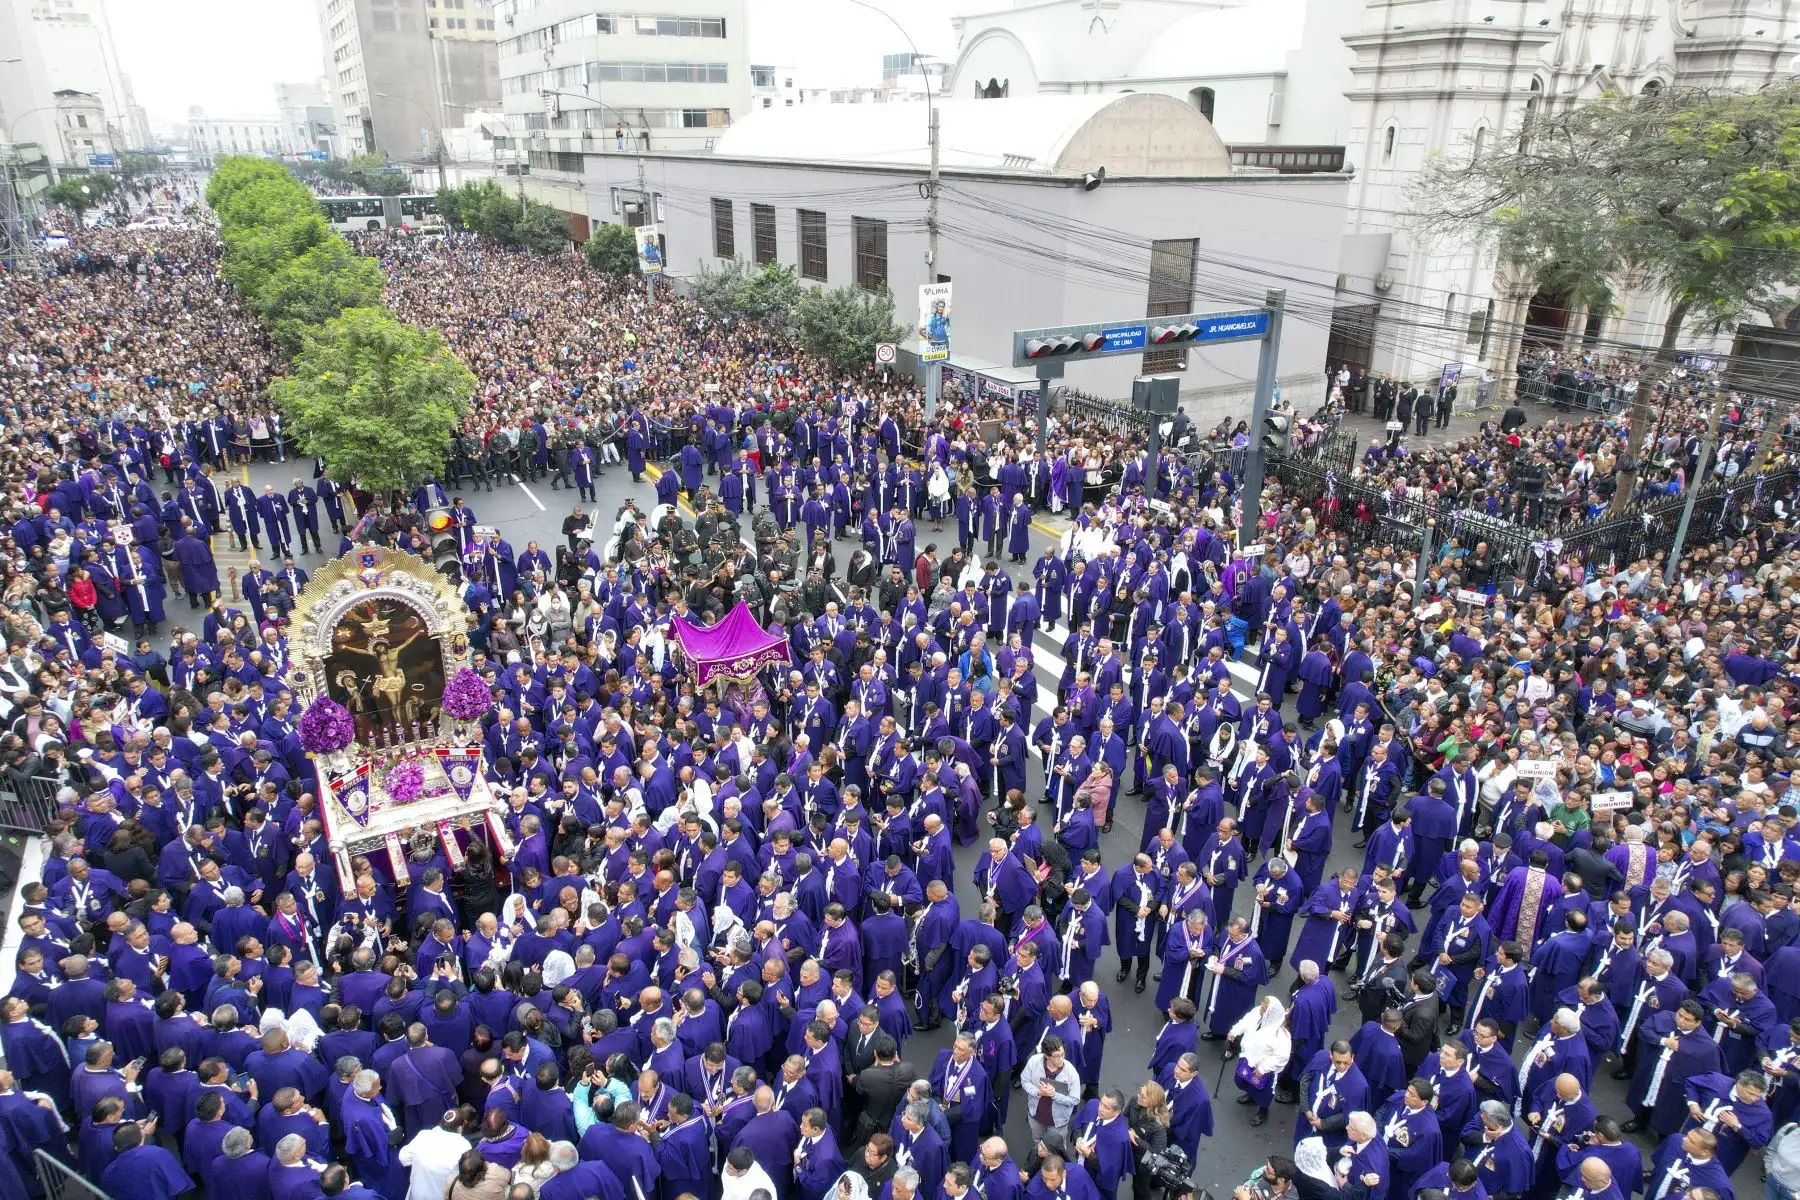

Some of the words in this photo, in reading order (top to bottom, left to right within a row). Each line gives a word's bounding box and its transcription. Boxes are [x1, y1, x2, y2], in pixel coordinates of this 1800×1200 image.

[931, 288, 949, 296] LIMA
[1218, 321, 1256, 332] HUANCAVELICA
[1105, 330, 1142, 340] MUNICIPALIDAD
[881, 348, 891, 356] 50
[988, 382, 998, 391] SAN
